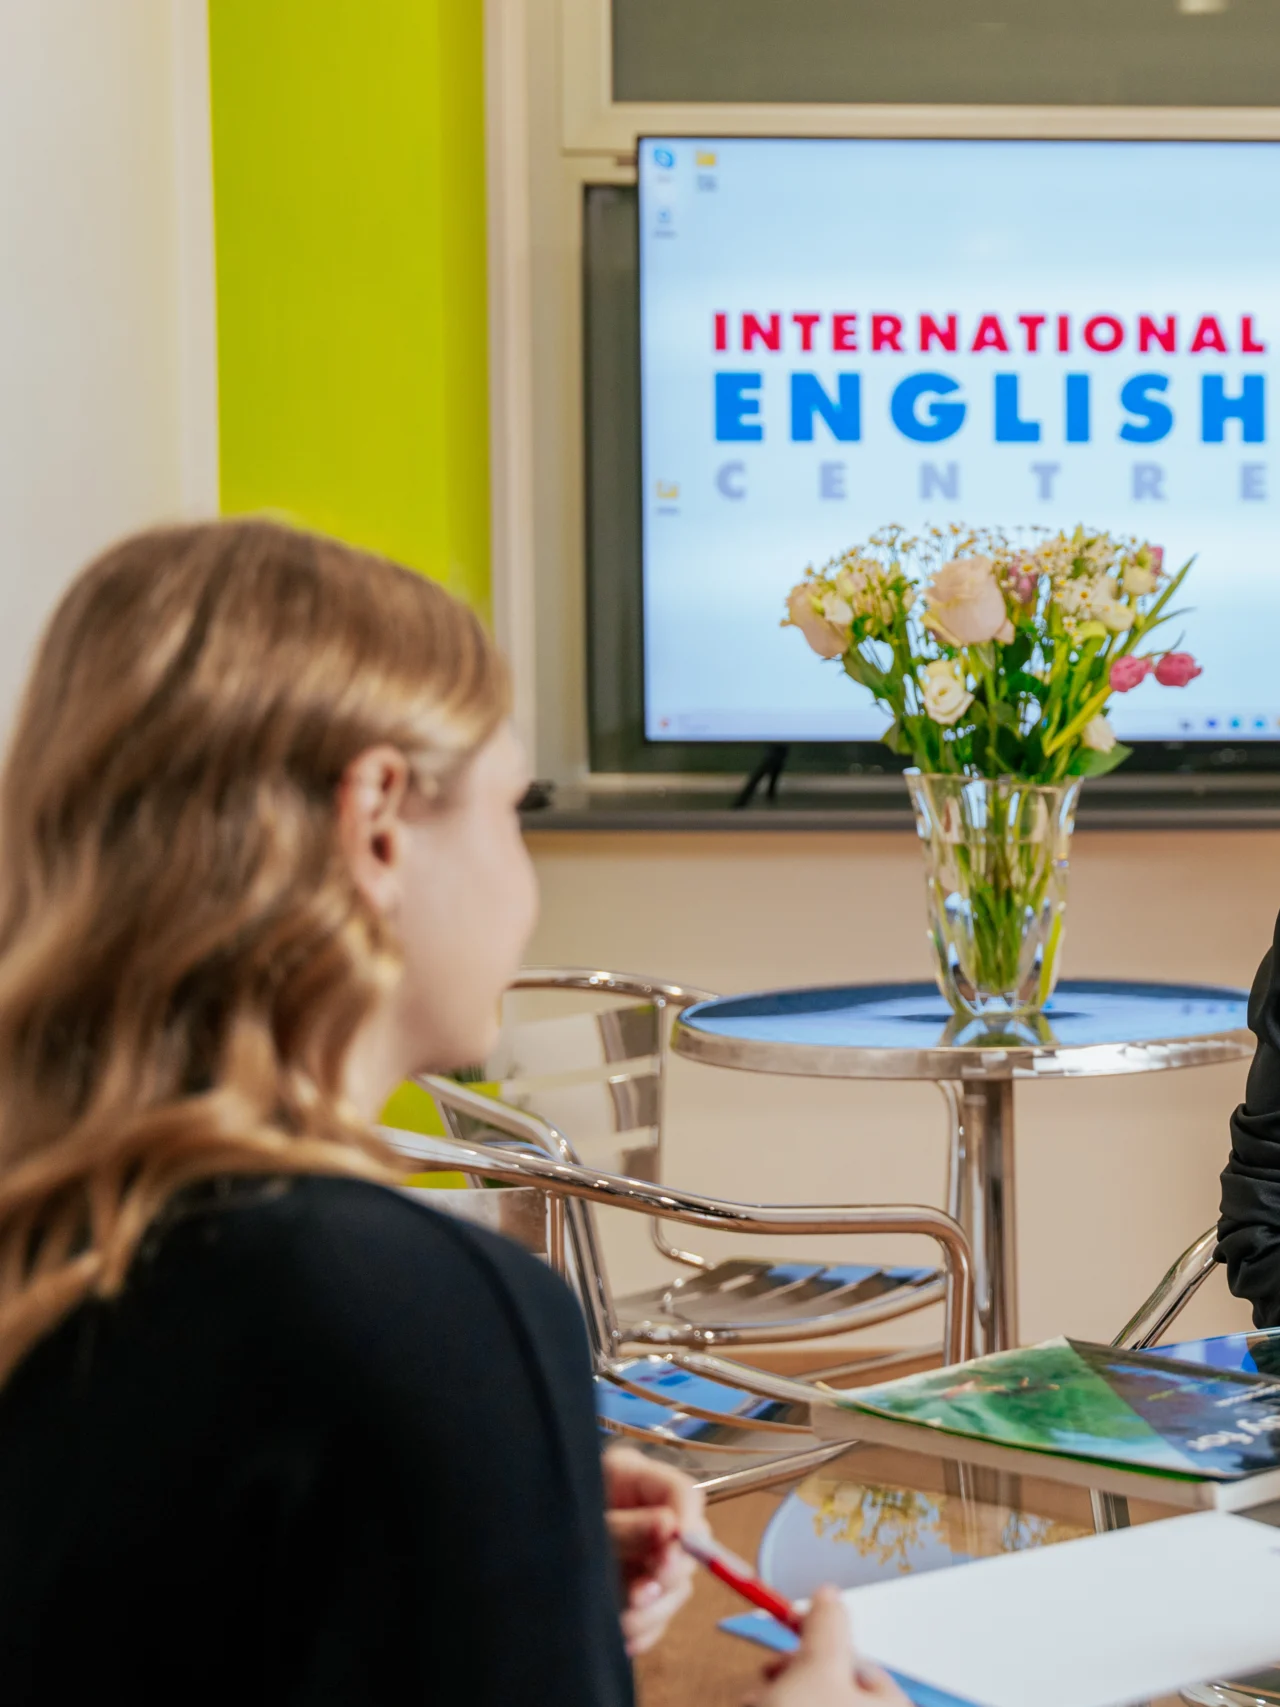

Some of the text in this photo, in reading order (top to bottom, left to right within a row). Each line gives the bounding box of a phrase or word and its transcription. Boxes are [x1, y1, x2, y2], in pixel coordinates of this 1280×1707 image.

[713, 312, 1266, 353] INTERNATIONAL
[714, 372, 1267, 443] ENGLISH
[715, 460, 1267, 501] CENTRE
